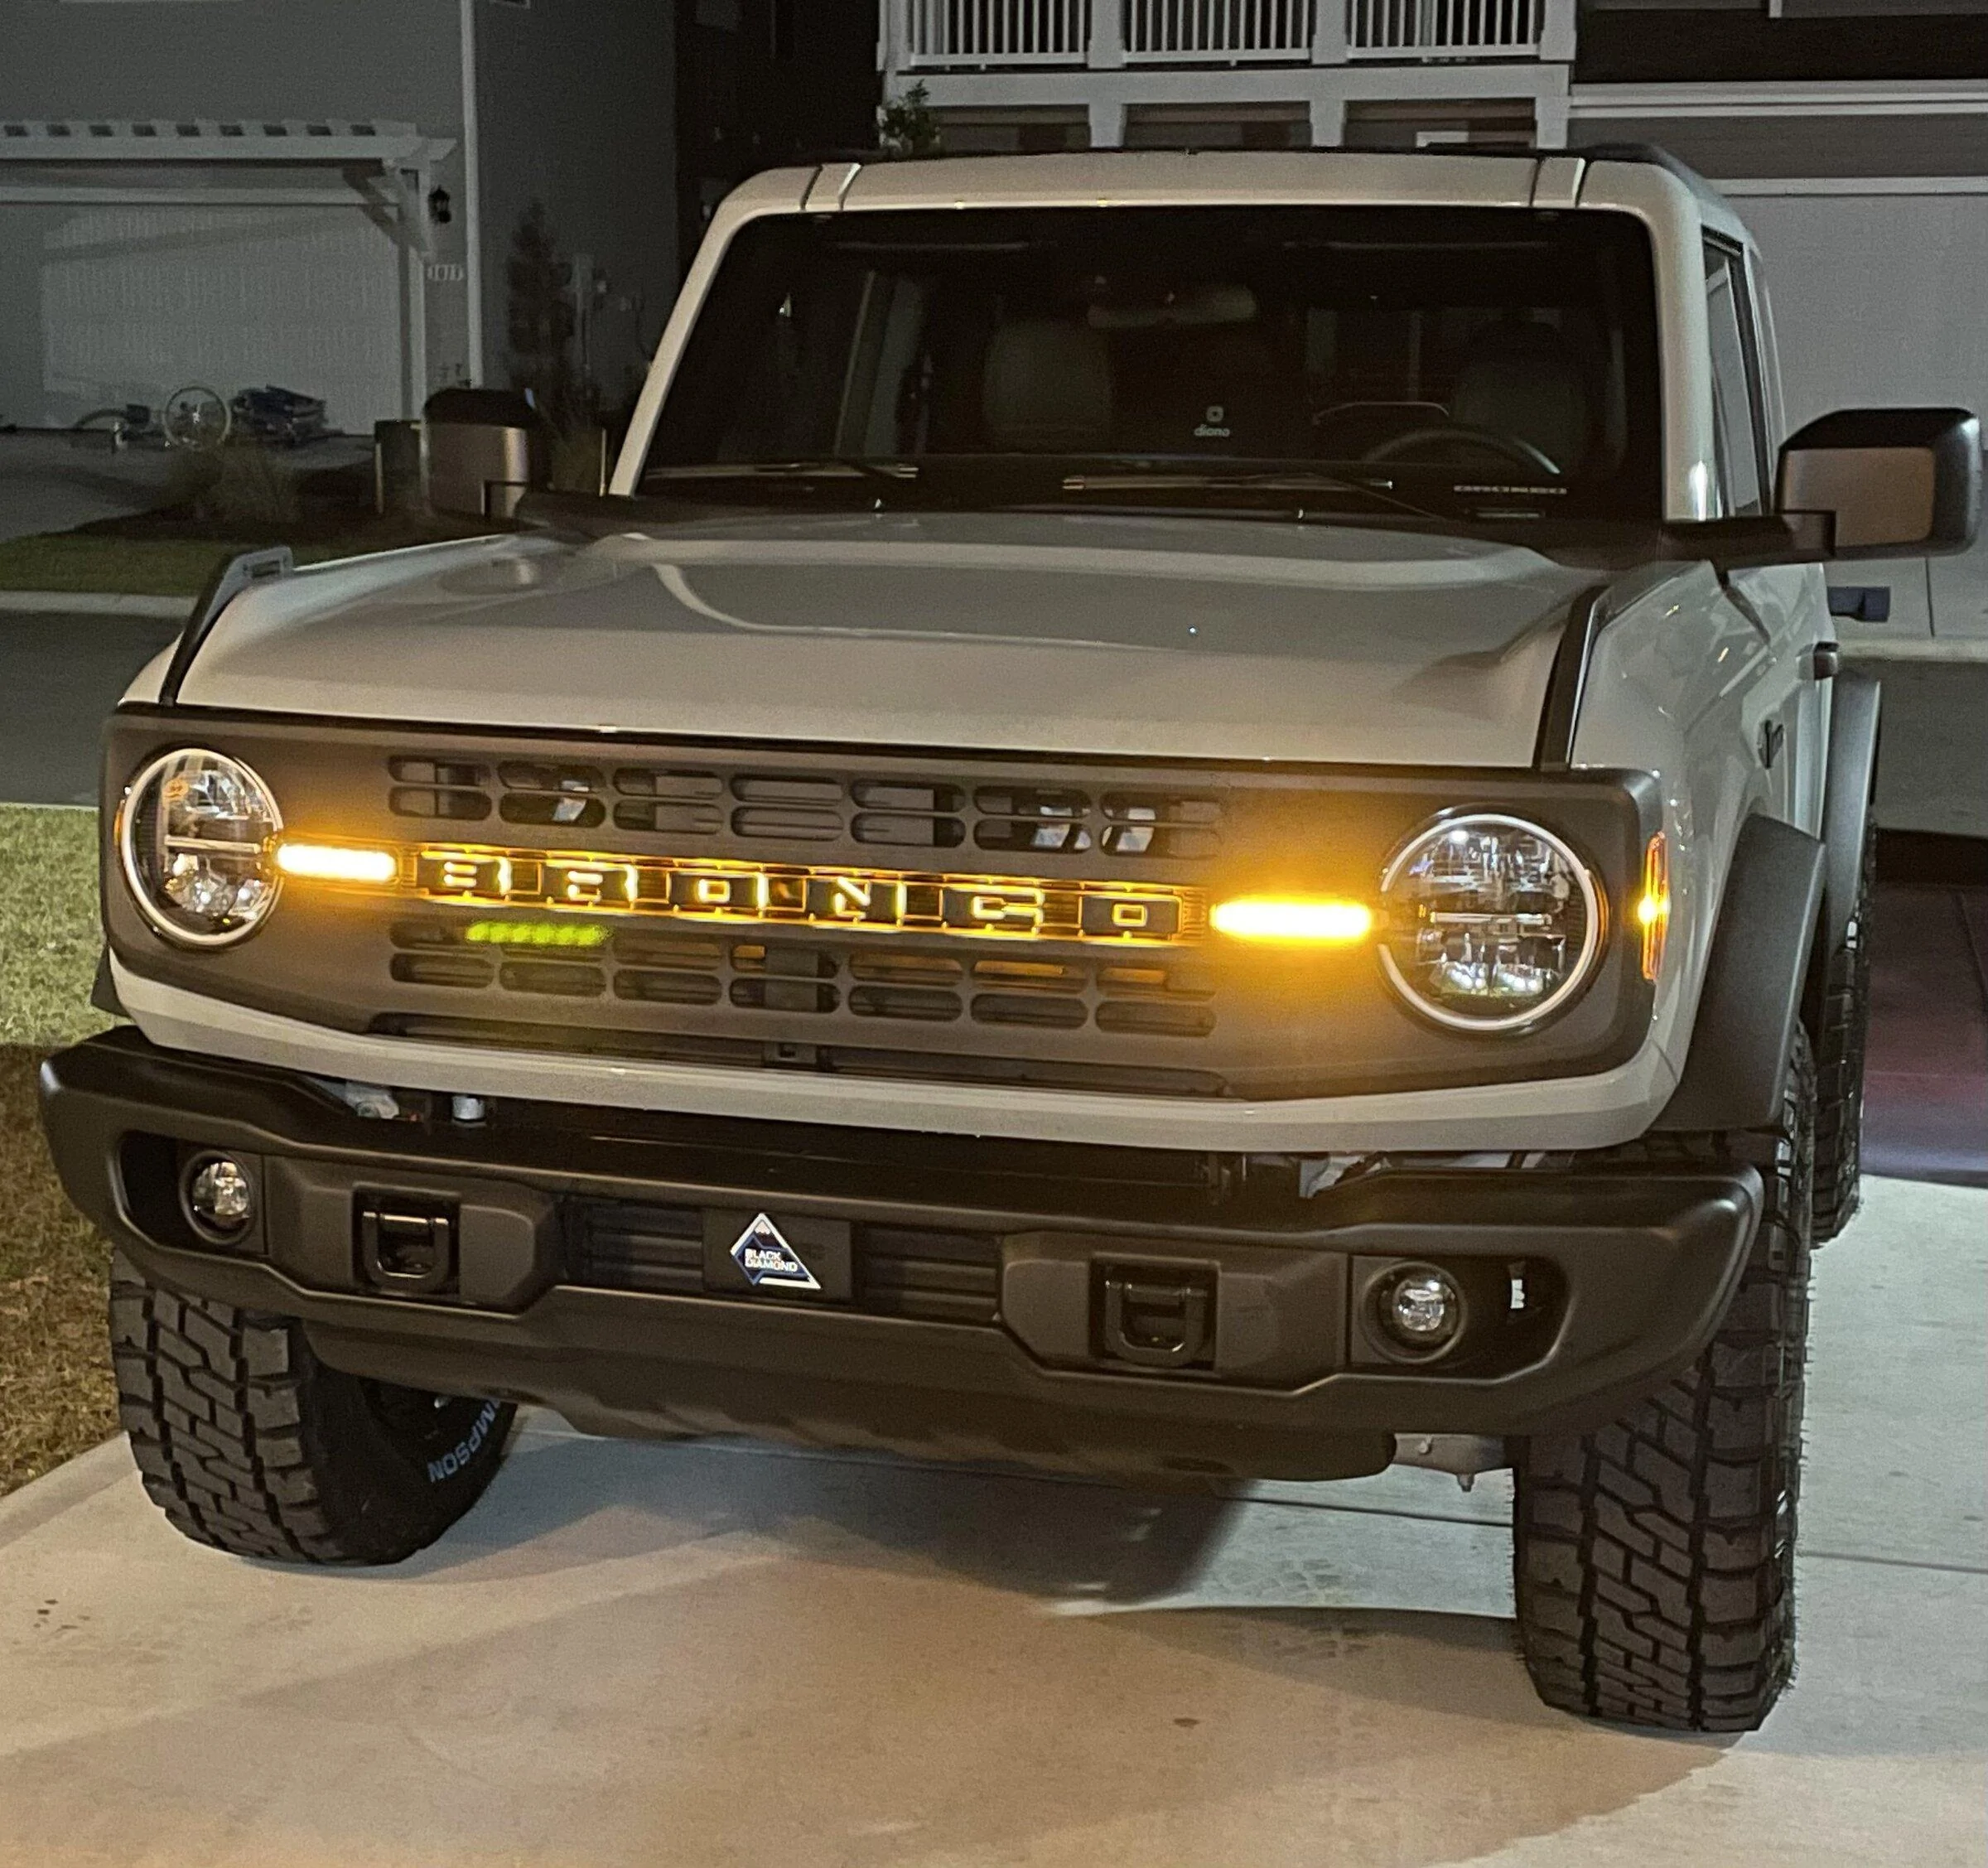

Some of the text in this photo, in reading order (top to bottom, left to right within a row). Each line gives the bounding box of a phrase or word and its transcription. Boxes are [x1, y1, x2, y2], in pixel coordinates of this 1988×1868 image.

[419, 850, 1184, 944] BRONCO
[745, 1248, 782, 1261] BLACK
[745, 1257, 799, 1272] DIAMOND
